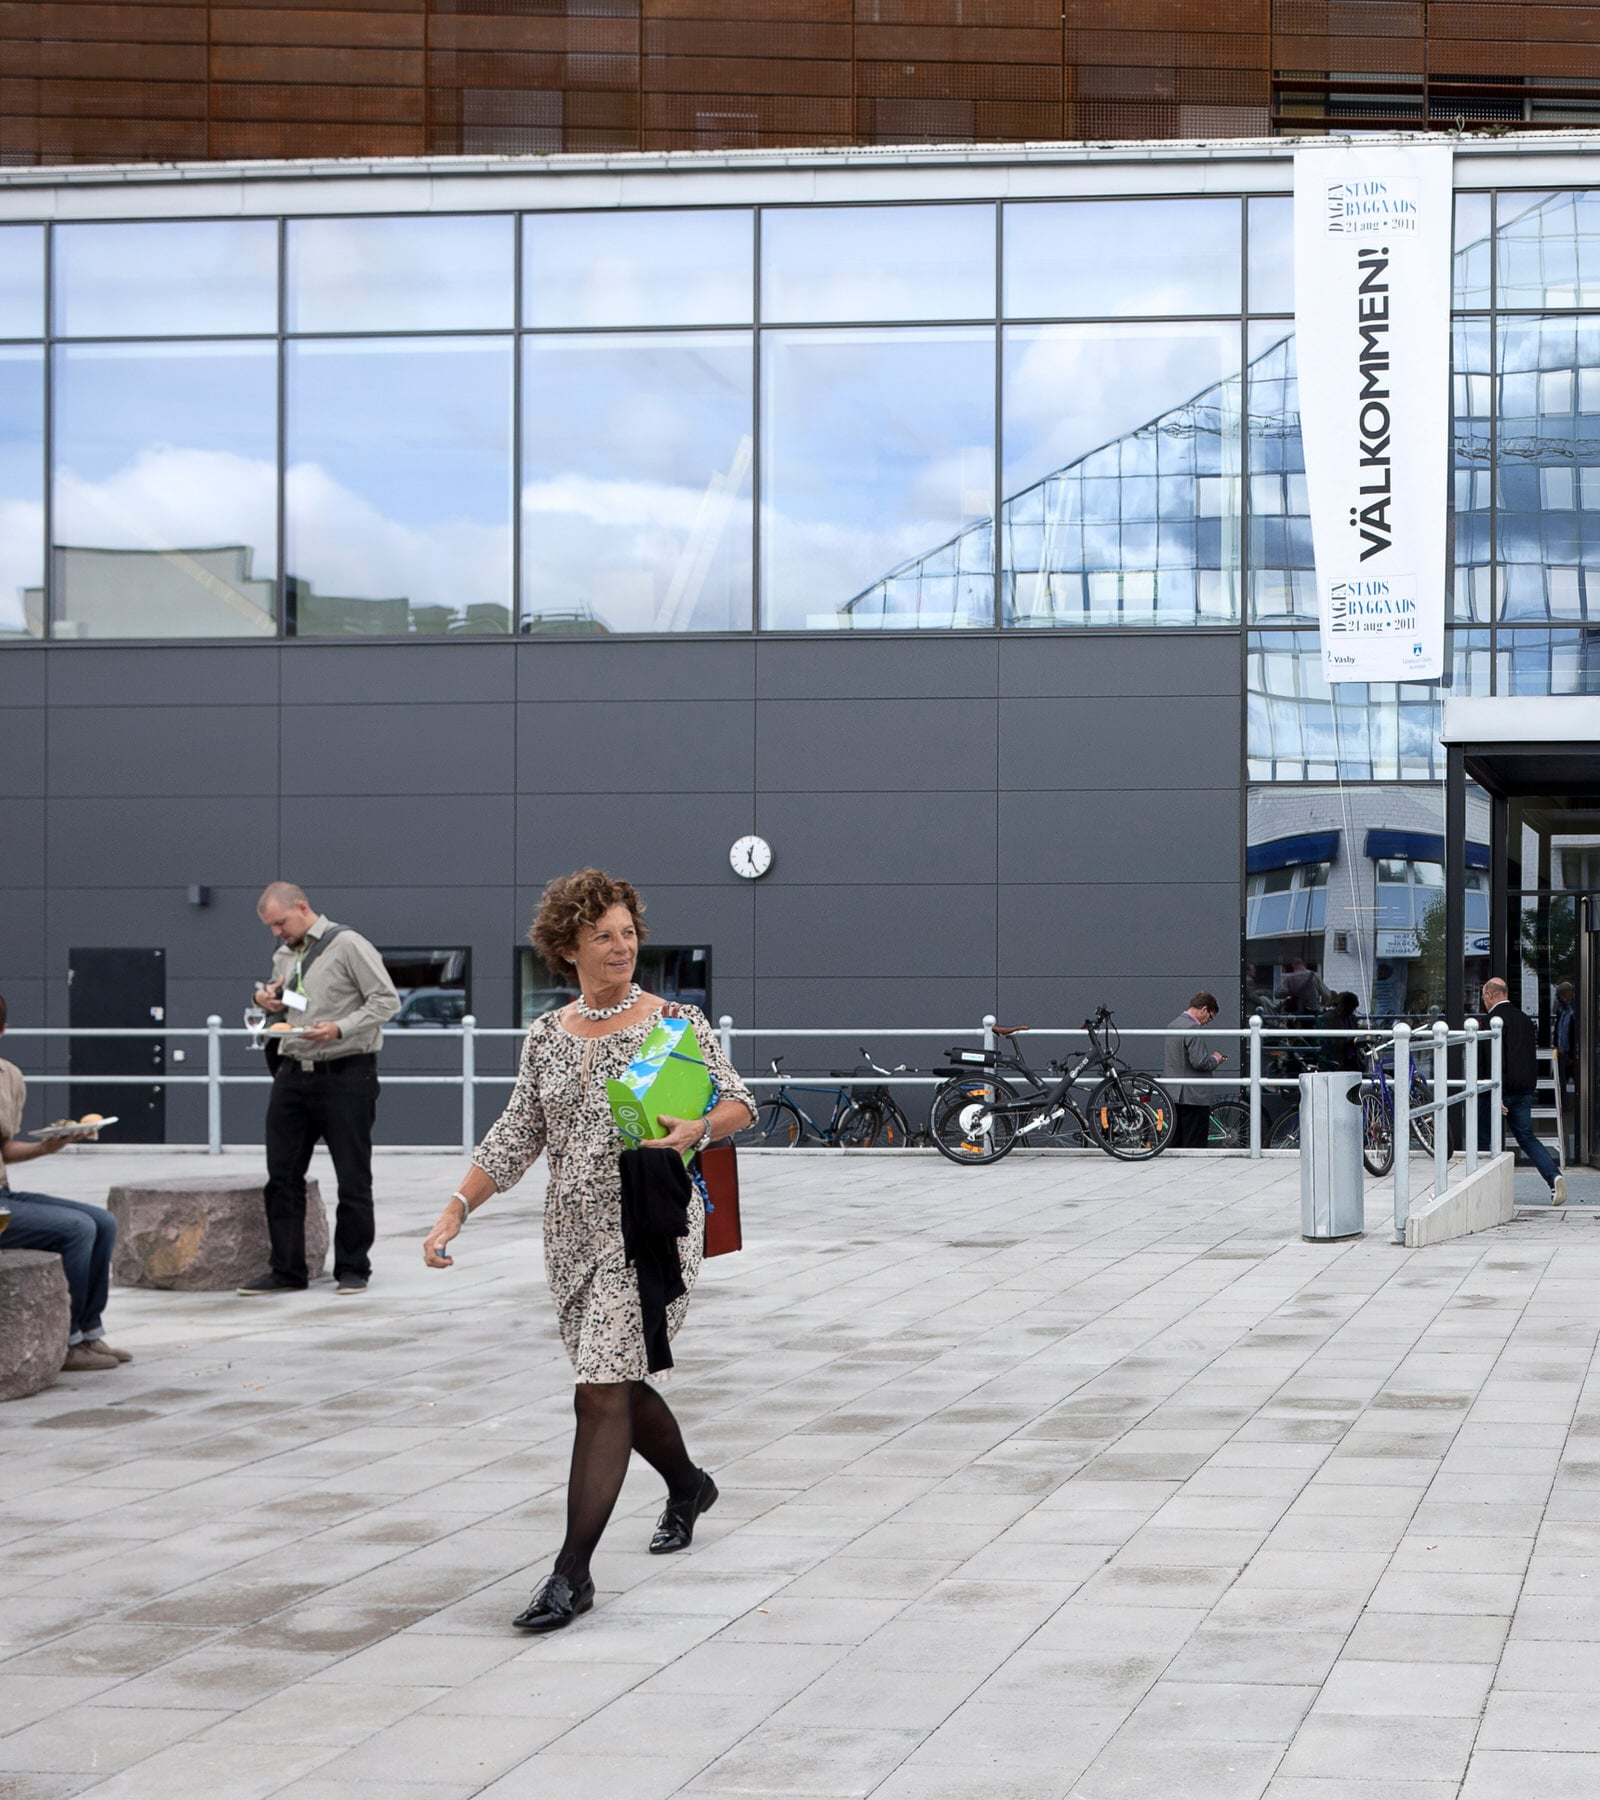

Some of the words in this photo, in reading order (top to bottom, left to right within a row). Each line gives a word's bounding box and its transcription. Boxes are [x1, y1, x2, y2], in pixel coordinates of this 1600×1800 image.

[1345, 181, 1388, 197] STADS
[1327, 183, 1344, 232] DAGEN
[1345, 199, 1417, 216] BYGGNADS
[1360, 222, 1380, 233] aug
[1391, 218, 1415, 231] 2011
[1349, 246, 1392, 563] VÄLKOMMEN!
[1348, 580, 1390, 596] STADS
[1331, 583, 1347, 632] DAGEN
[1348, 598, 1416, 615] BYGGNADS
[1363, 622, 1383, 634] aug
[1394, 617, 1415, 630] 2011
